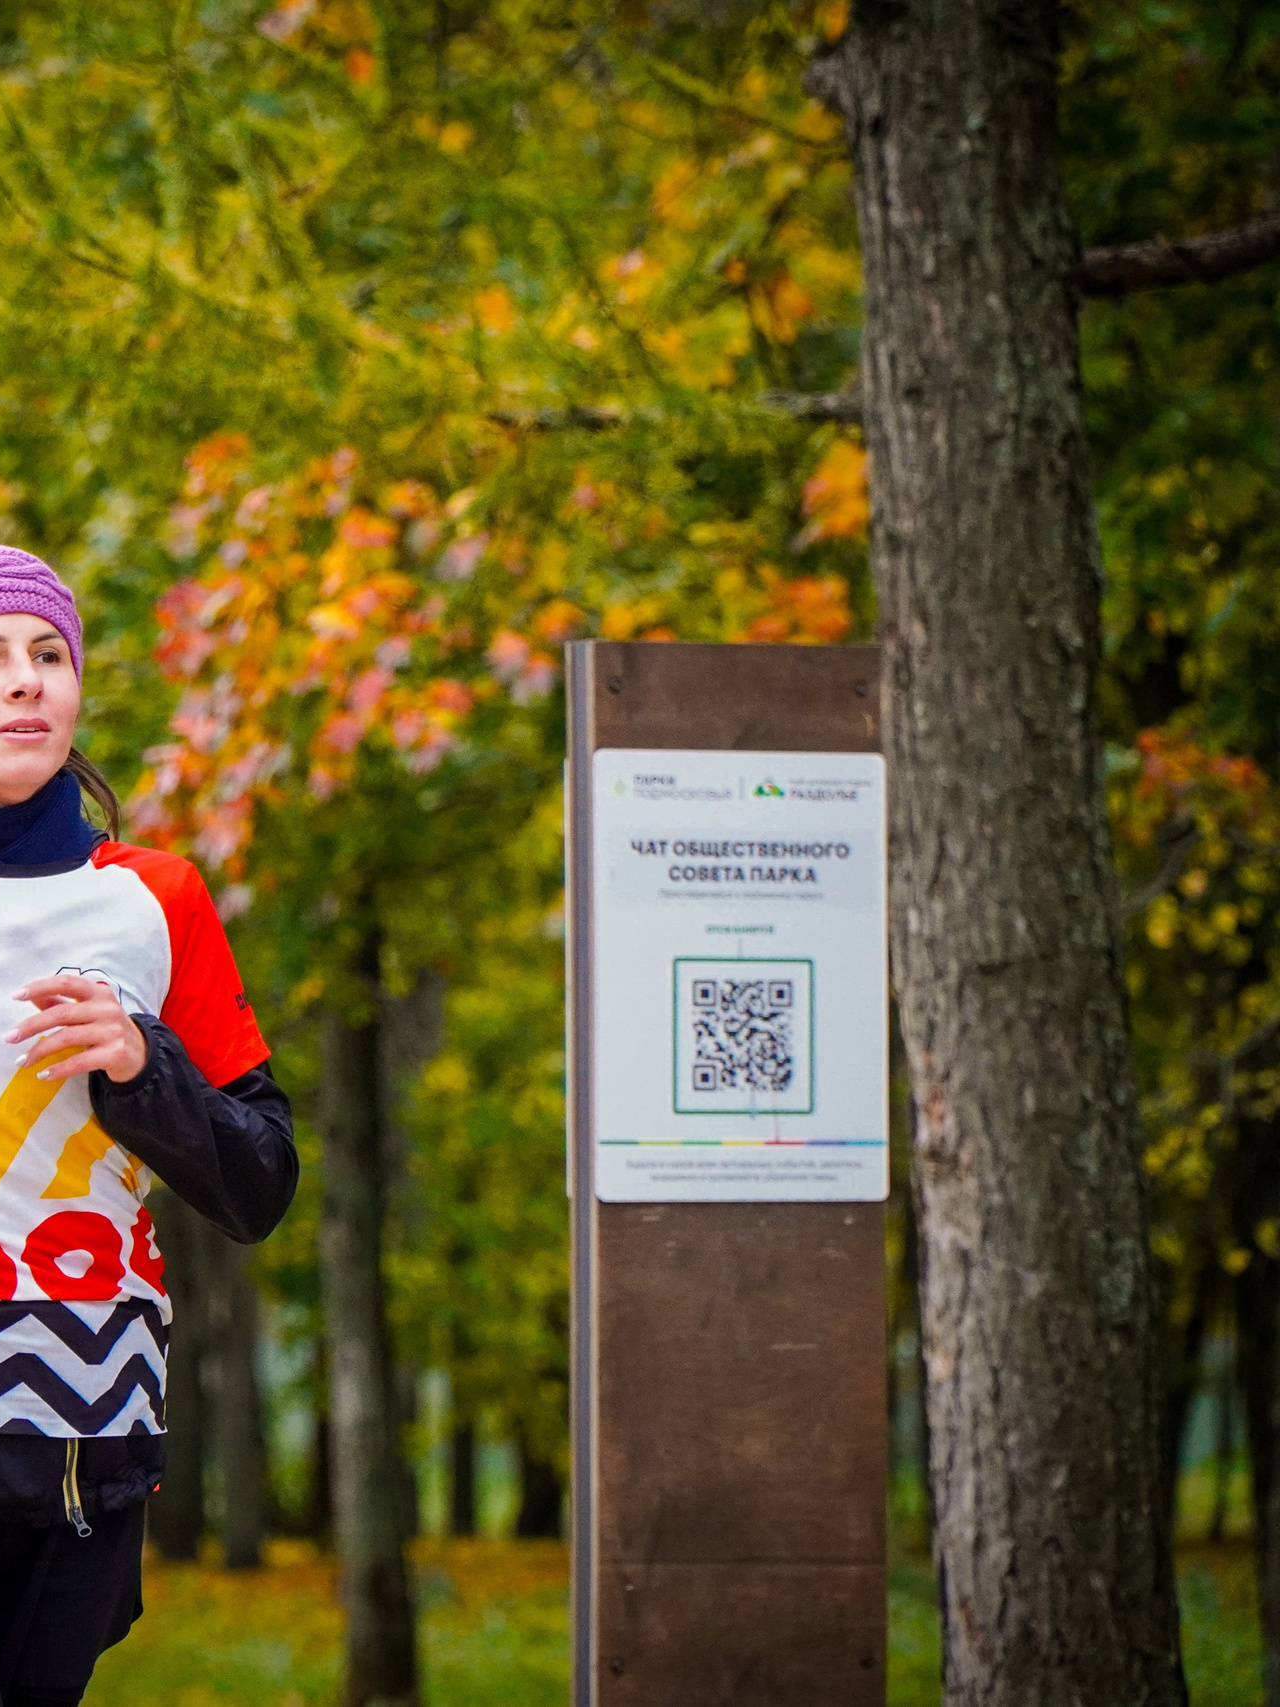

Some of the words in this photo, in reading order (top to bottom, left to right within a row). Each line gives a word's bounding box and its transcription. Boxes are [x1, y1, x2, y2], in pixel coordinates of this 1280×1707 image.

[630, 839, 668, 857] ЧАТ
[672, 840, 851, 860] ОБЩЕСТВЕННОГО
[668, 865, 745, 882] СОВЕТА
[750, 866, 817, 883] ПАРКА
